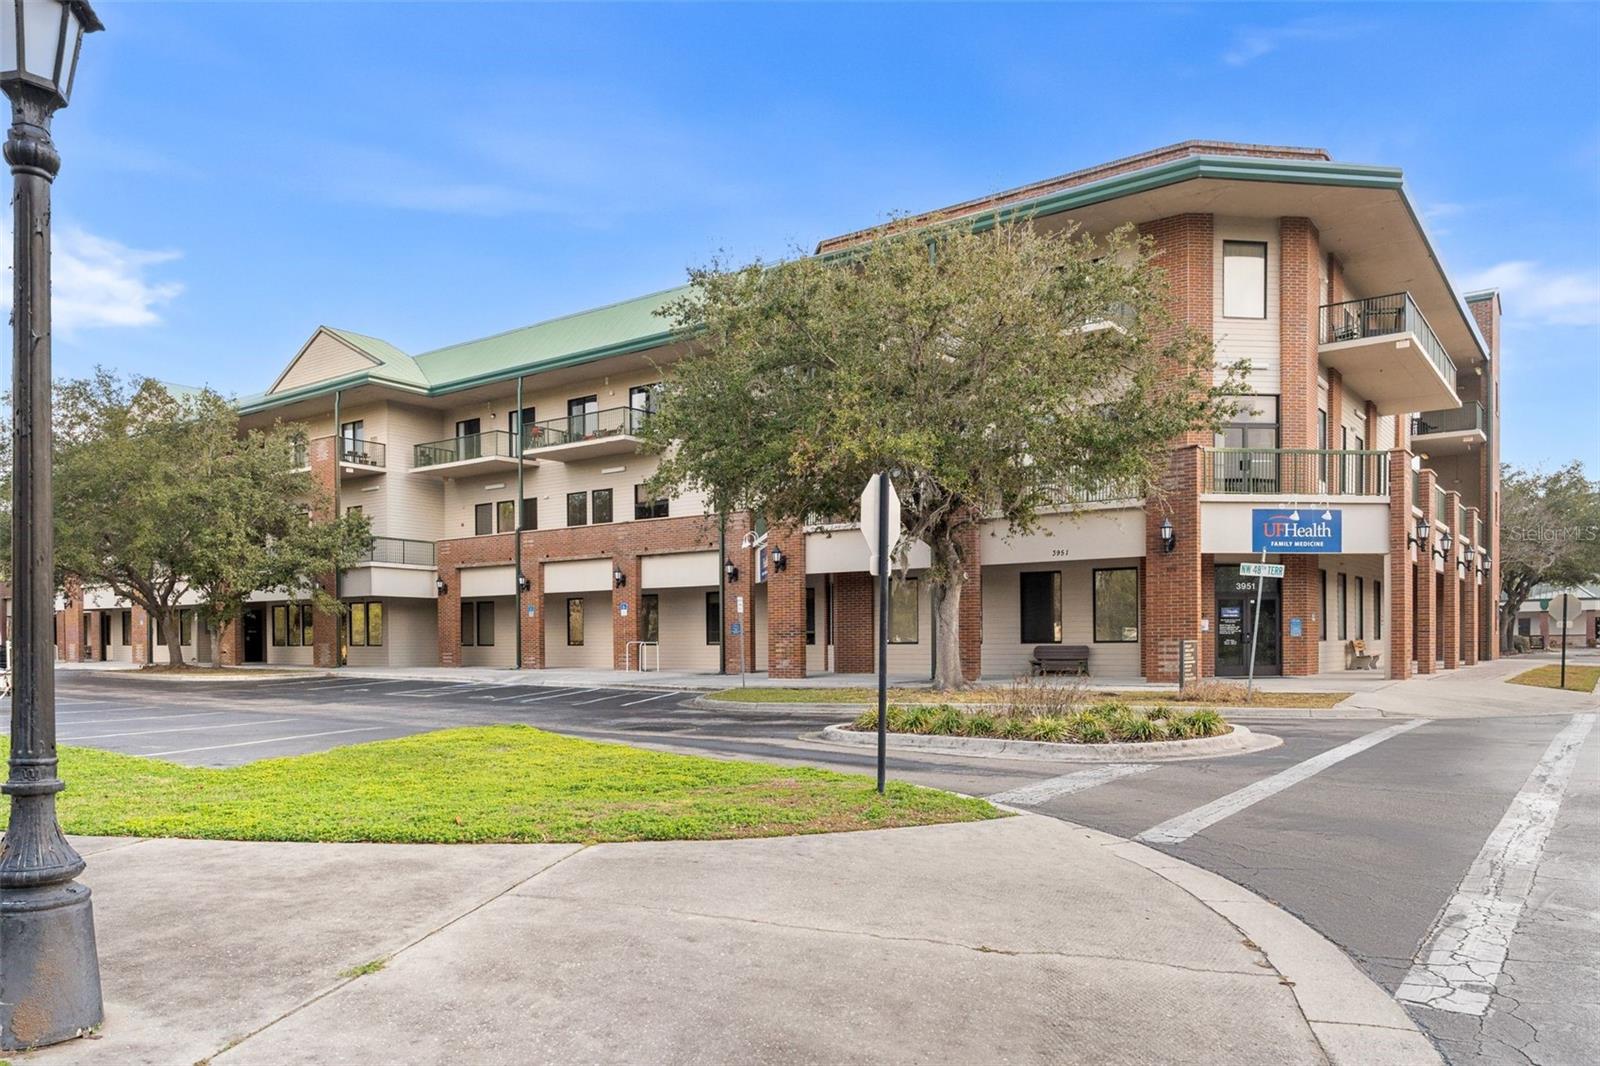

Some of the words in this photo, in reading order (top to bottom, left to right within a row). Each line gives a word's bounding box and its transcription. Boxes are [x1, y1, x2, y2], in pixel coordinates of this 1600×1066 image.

[1052, 549, 1069, 557] 3951
[1241, 564, 1251, 574] NW
[1267, 565, 1283, 577] TERR
[1235, 582, 1256, 590] 3951
